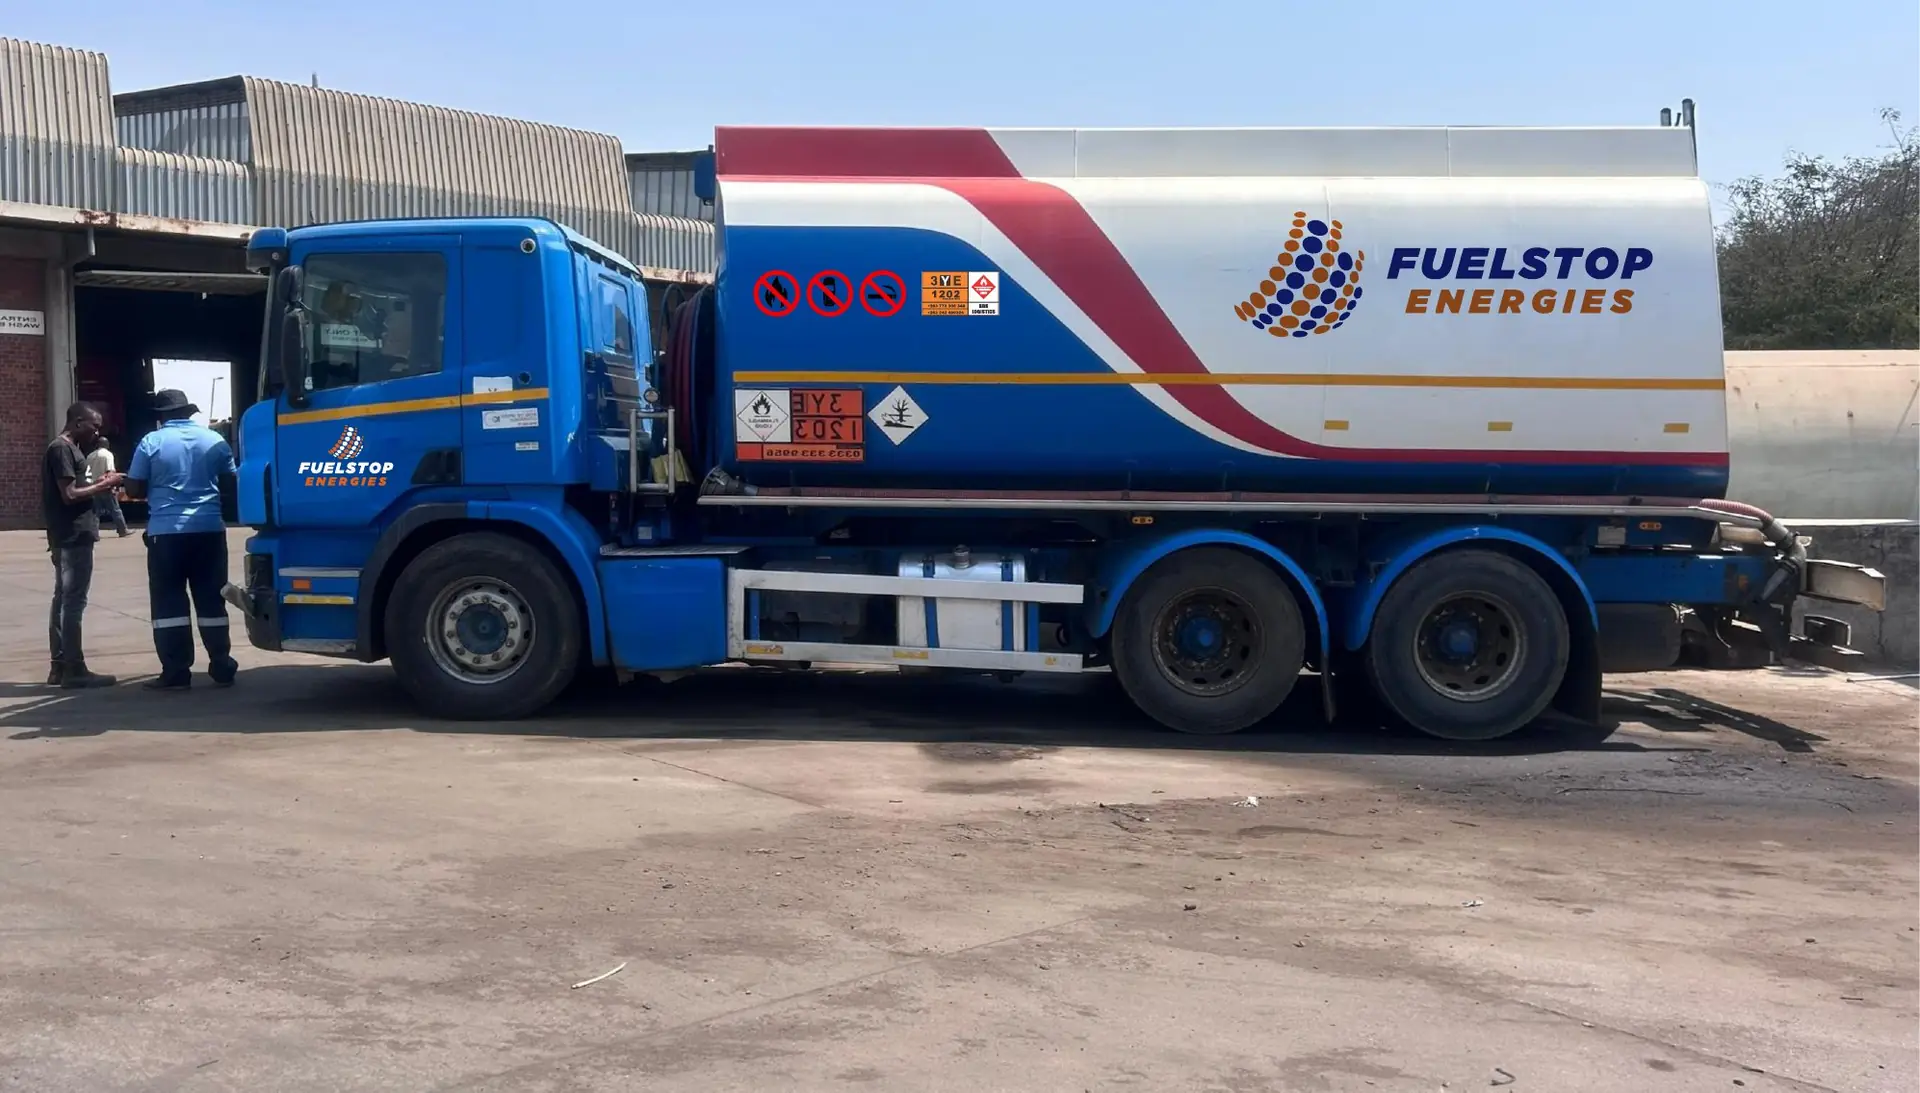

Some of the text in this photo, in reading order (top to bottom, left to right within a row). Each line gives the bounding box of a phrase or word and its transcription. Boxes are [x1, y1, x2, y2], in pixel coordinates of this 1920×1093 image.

[1387, 247, 1653, 280] FUELSTOP
[930, 275, 961, 286] 3YE
[932, 290, 960, 298] 1202
[1405, 289, 1635, 314] ENERGIES
[298, 462, 394, 474] FUELSTOP
[305, 477, 387, 486] ENERGIES
